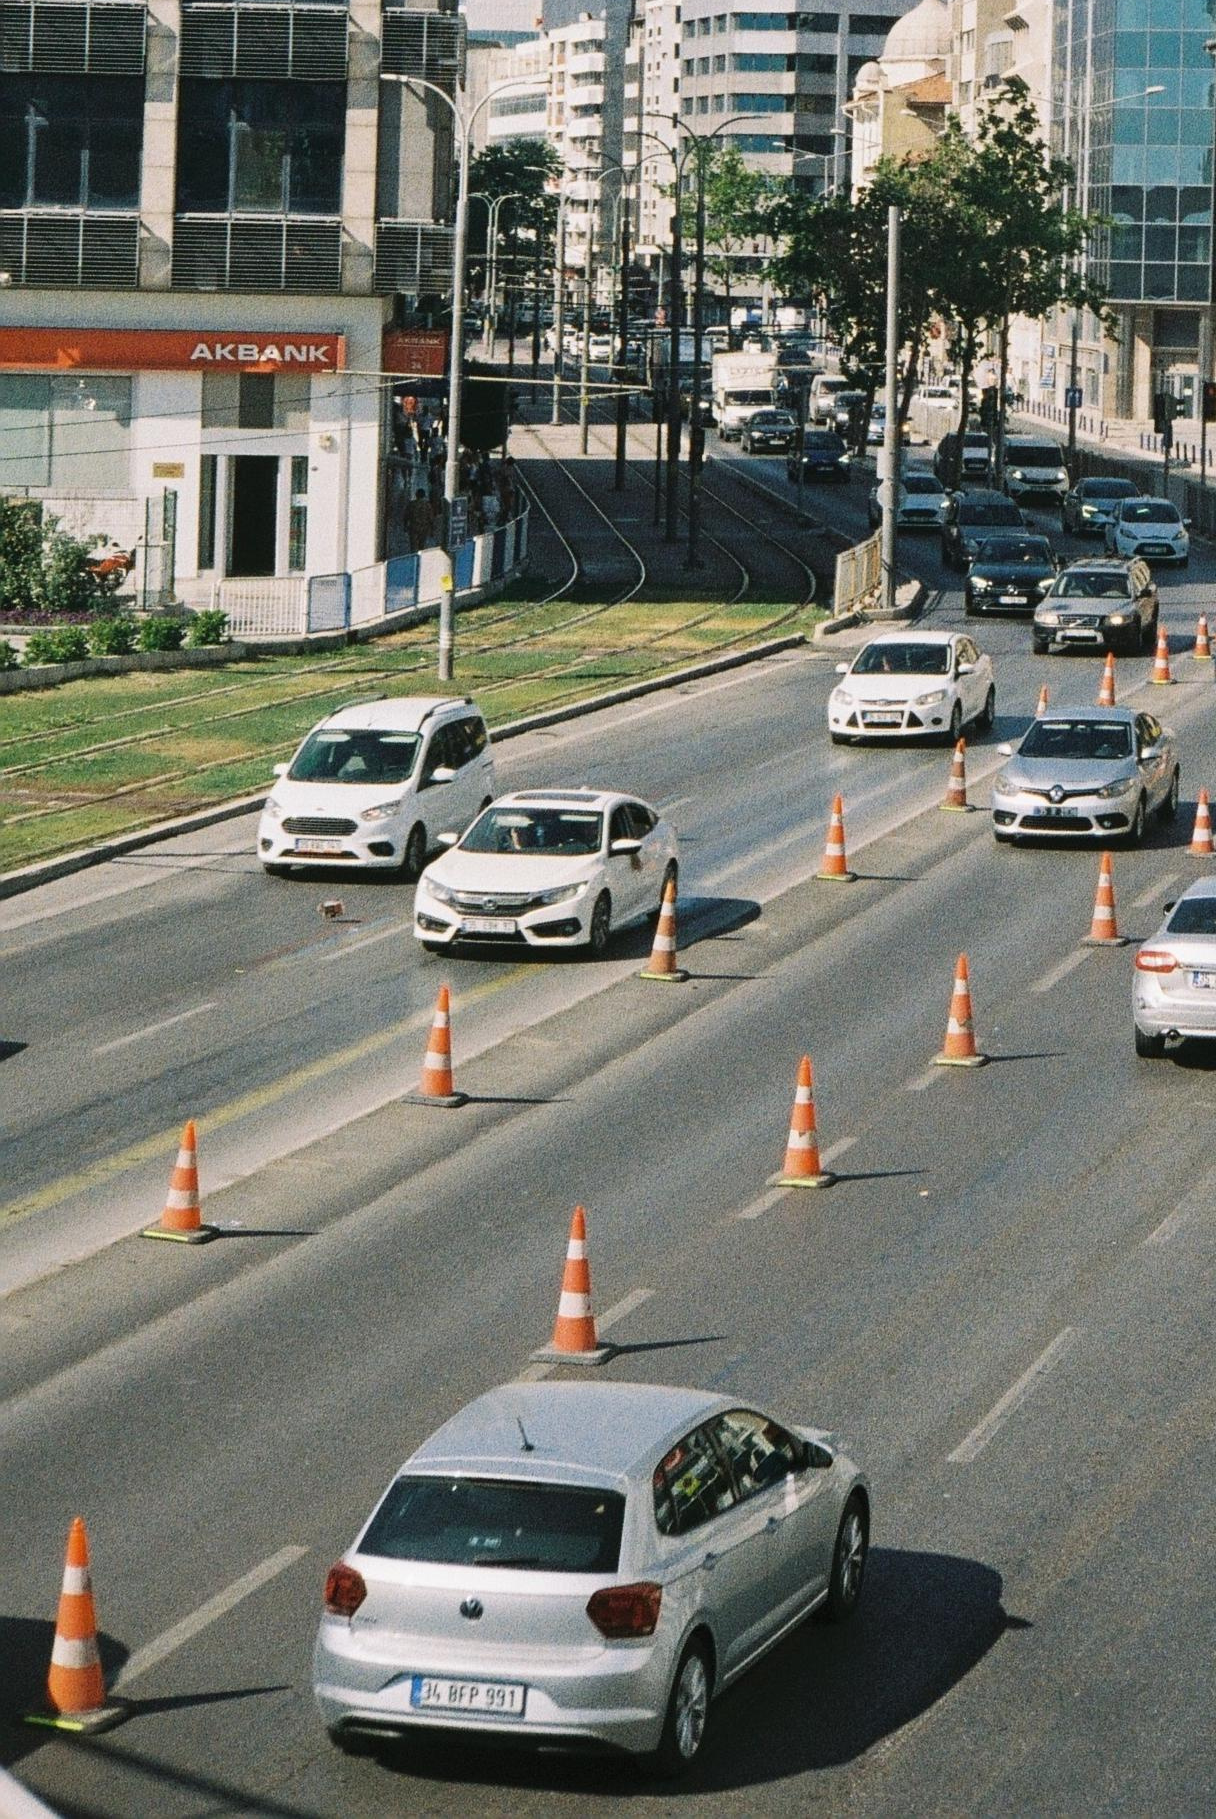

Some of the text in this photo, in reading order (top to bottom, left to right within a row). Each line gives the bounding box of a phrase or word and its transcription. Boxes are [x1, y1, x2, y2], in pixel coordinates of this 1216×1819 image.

[190, 343, 331, 362] AKBANK
[425, 1683, 515, 1708] 34 BFP 991
